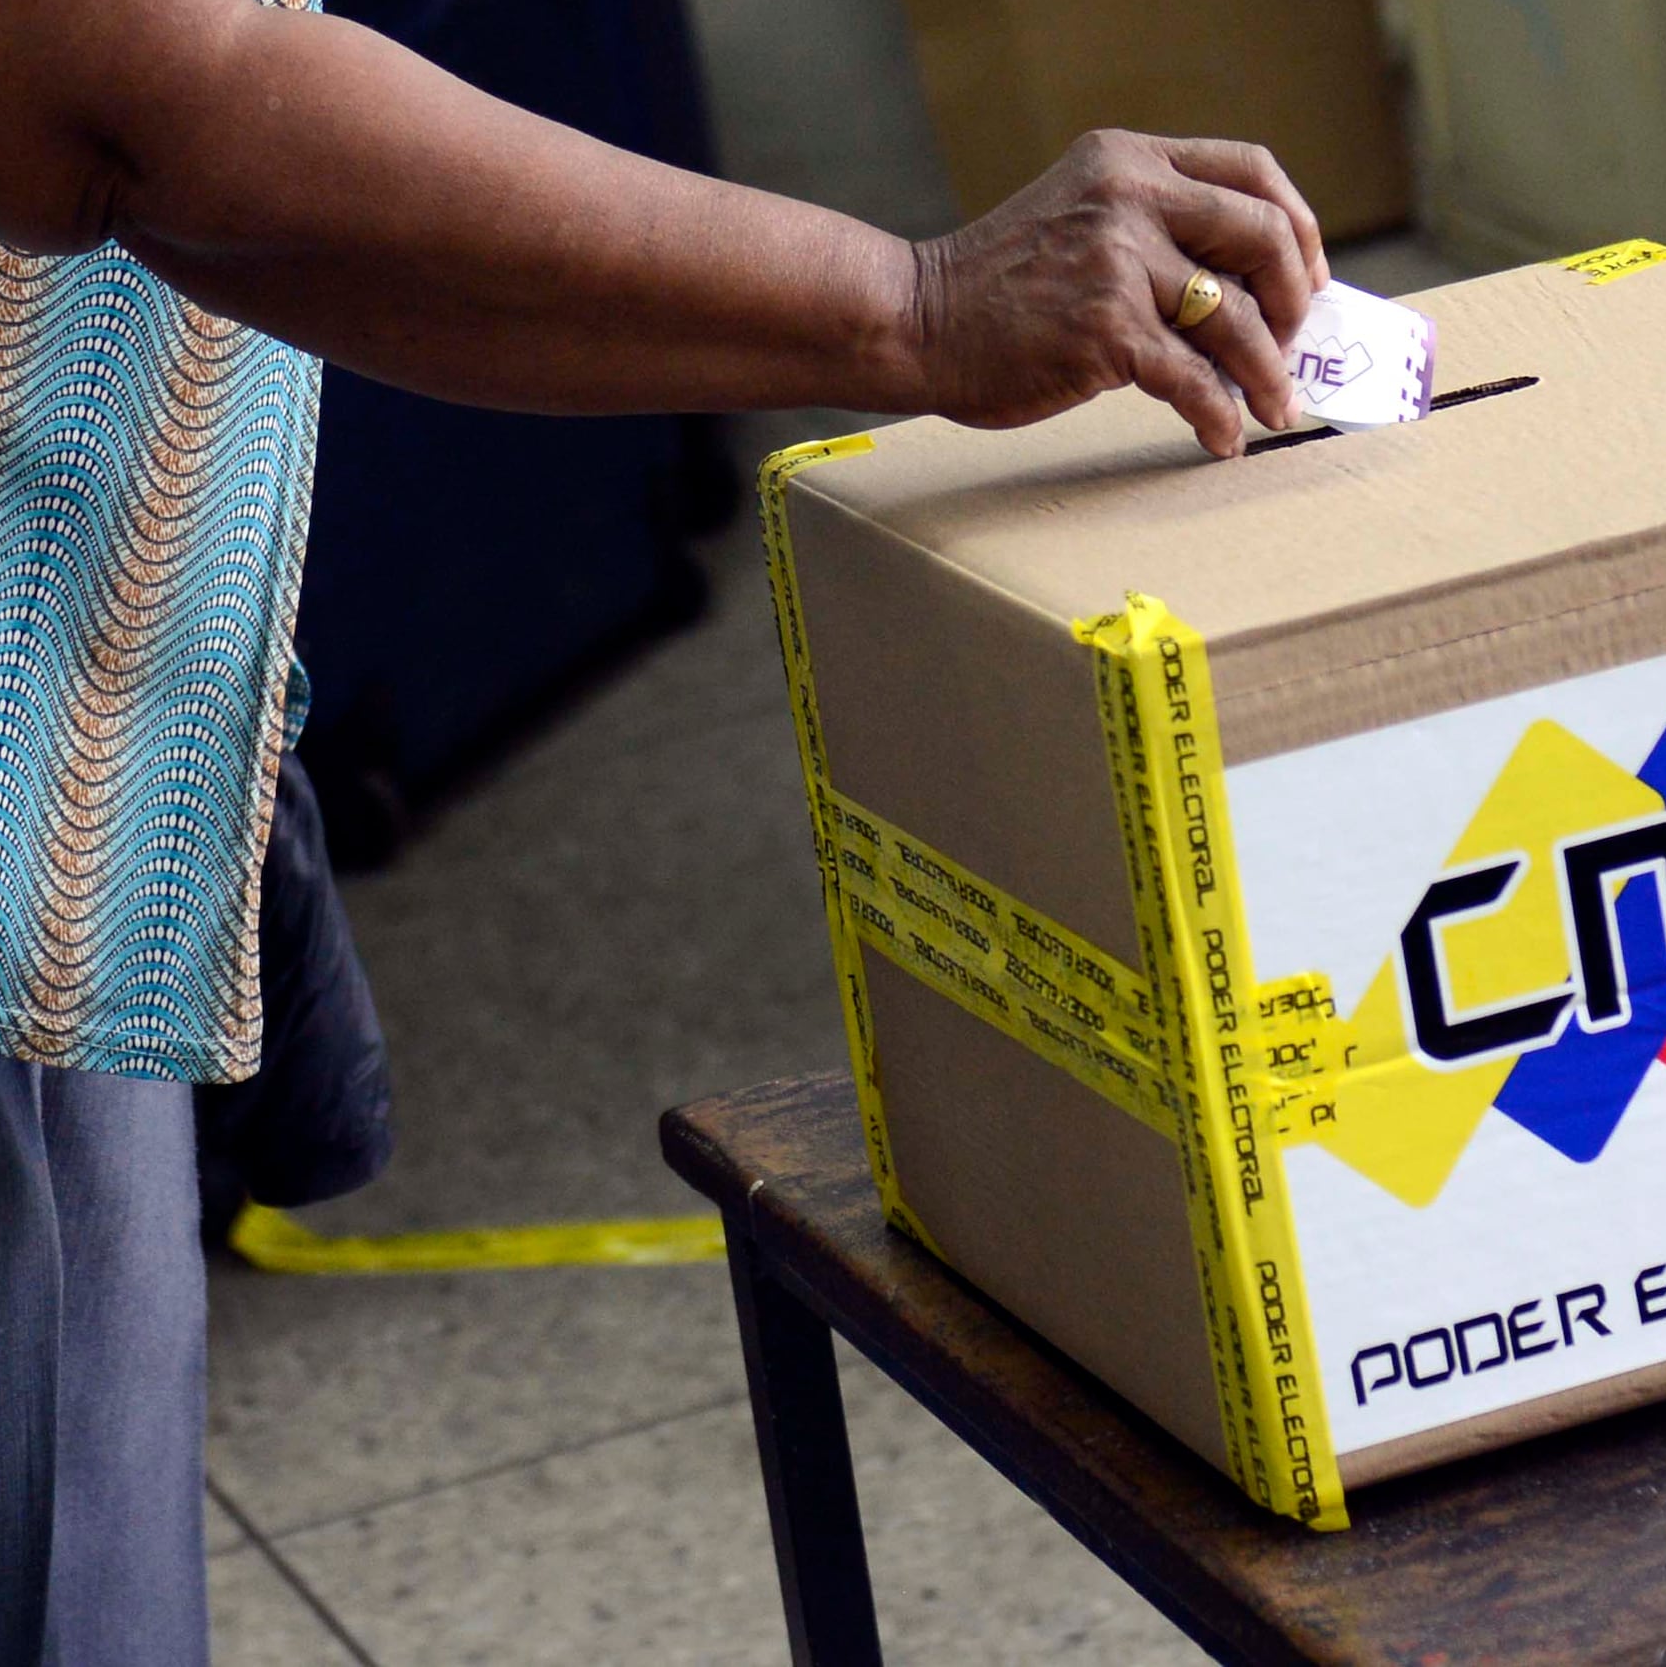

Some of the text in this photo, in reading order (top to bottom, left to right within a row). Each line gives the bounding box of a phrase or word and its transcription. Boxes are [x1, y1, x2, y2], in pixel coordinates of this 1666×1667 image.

[1289, 350, 1346, 387] NE
[1203, 928, 1238, 1034] PODER
[1256, 1260, 1293, 1366] PODER
[1350, 1282, 1610, 1407] PODER
